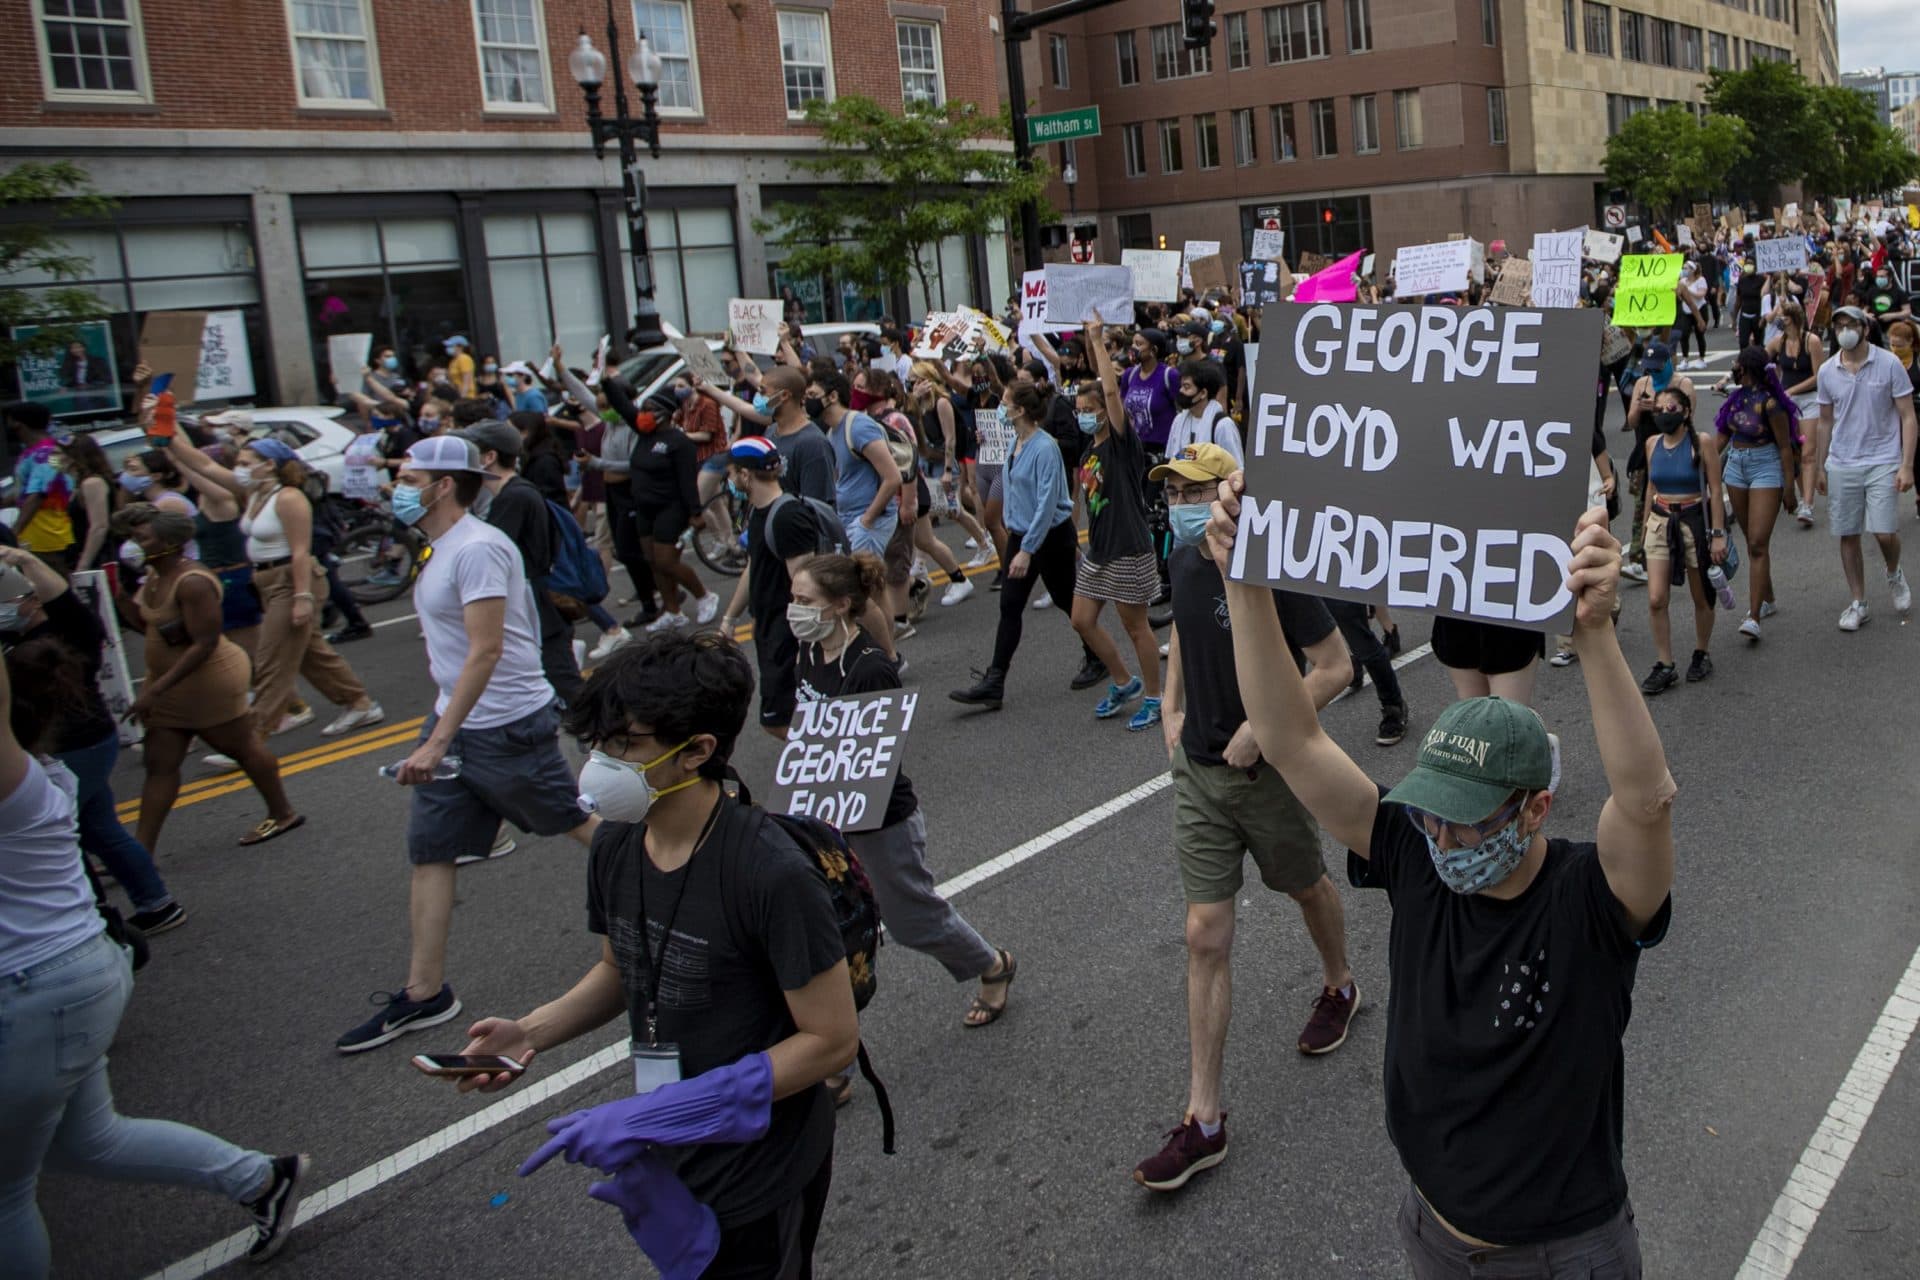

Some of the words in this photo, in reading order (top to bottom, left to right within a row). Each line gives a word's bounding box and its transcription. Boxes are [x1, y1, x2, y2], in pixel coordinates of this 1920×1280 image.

[1034, 119, 1080, 137] Waltham
[1084, 118, 1092, 130] St
[1539, 237, 1577, 258] FUCK
[1535, 264, 1578, 286] WHITE
[1637, 257, 1667, 277] NO
[733, 304, 767, 320] BLACK
[1629, 293, 1658, 312] NO
[1295, 304, 1543, 384] GEORGE
[1255, 392, 1398, 471] FLOYD
[1448, 417, 1571, 478] WAS
[1230, 496, 1573, 622] MURDERED
[787, 696, 892, 740] JUSTICE
[901, 693, 918, 731] 4
[776, 736, 897, 785] GEORGE
[1449, 734, 1491, 767] JUAN
[1451, 753, 1472, 764] RICO
[787, 790, 866, 829] FLOYD
